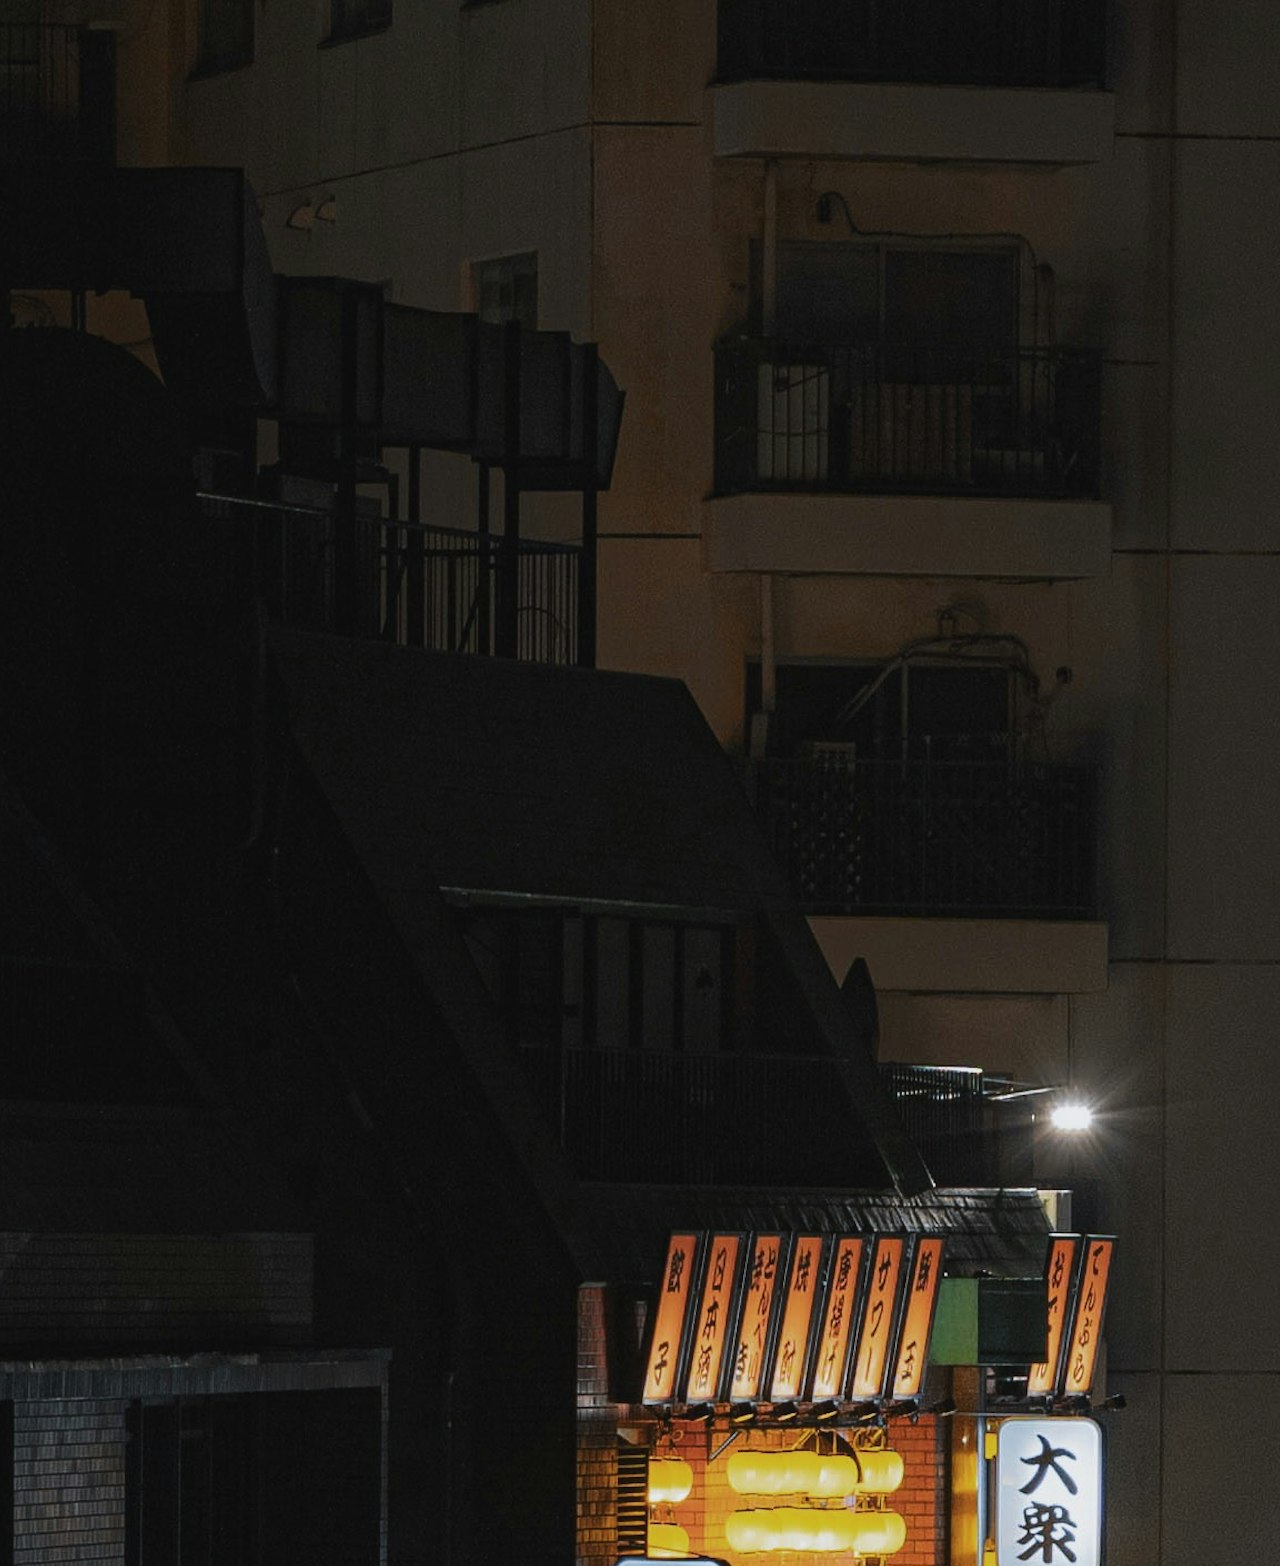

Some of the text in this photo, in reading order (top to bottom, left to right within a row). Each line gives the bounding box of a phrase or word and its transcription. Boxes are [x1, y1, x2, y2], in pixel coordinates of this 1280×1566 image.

[696, 1248, 727, 1389] 日本酒
[864, 1252, 892, 1382] サワー
[1074, 1245, 1104, 1383] てんぷら
[1017, 1434, 1078, 1564] 大衆
